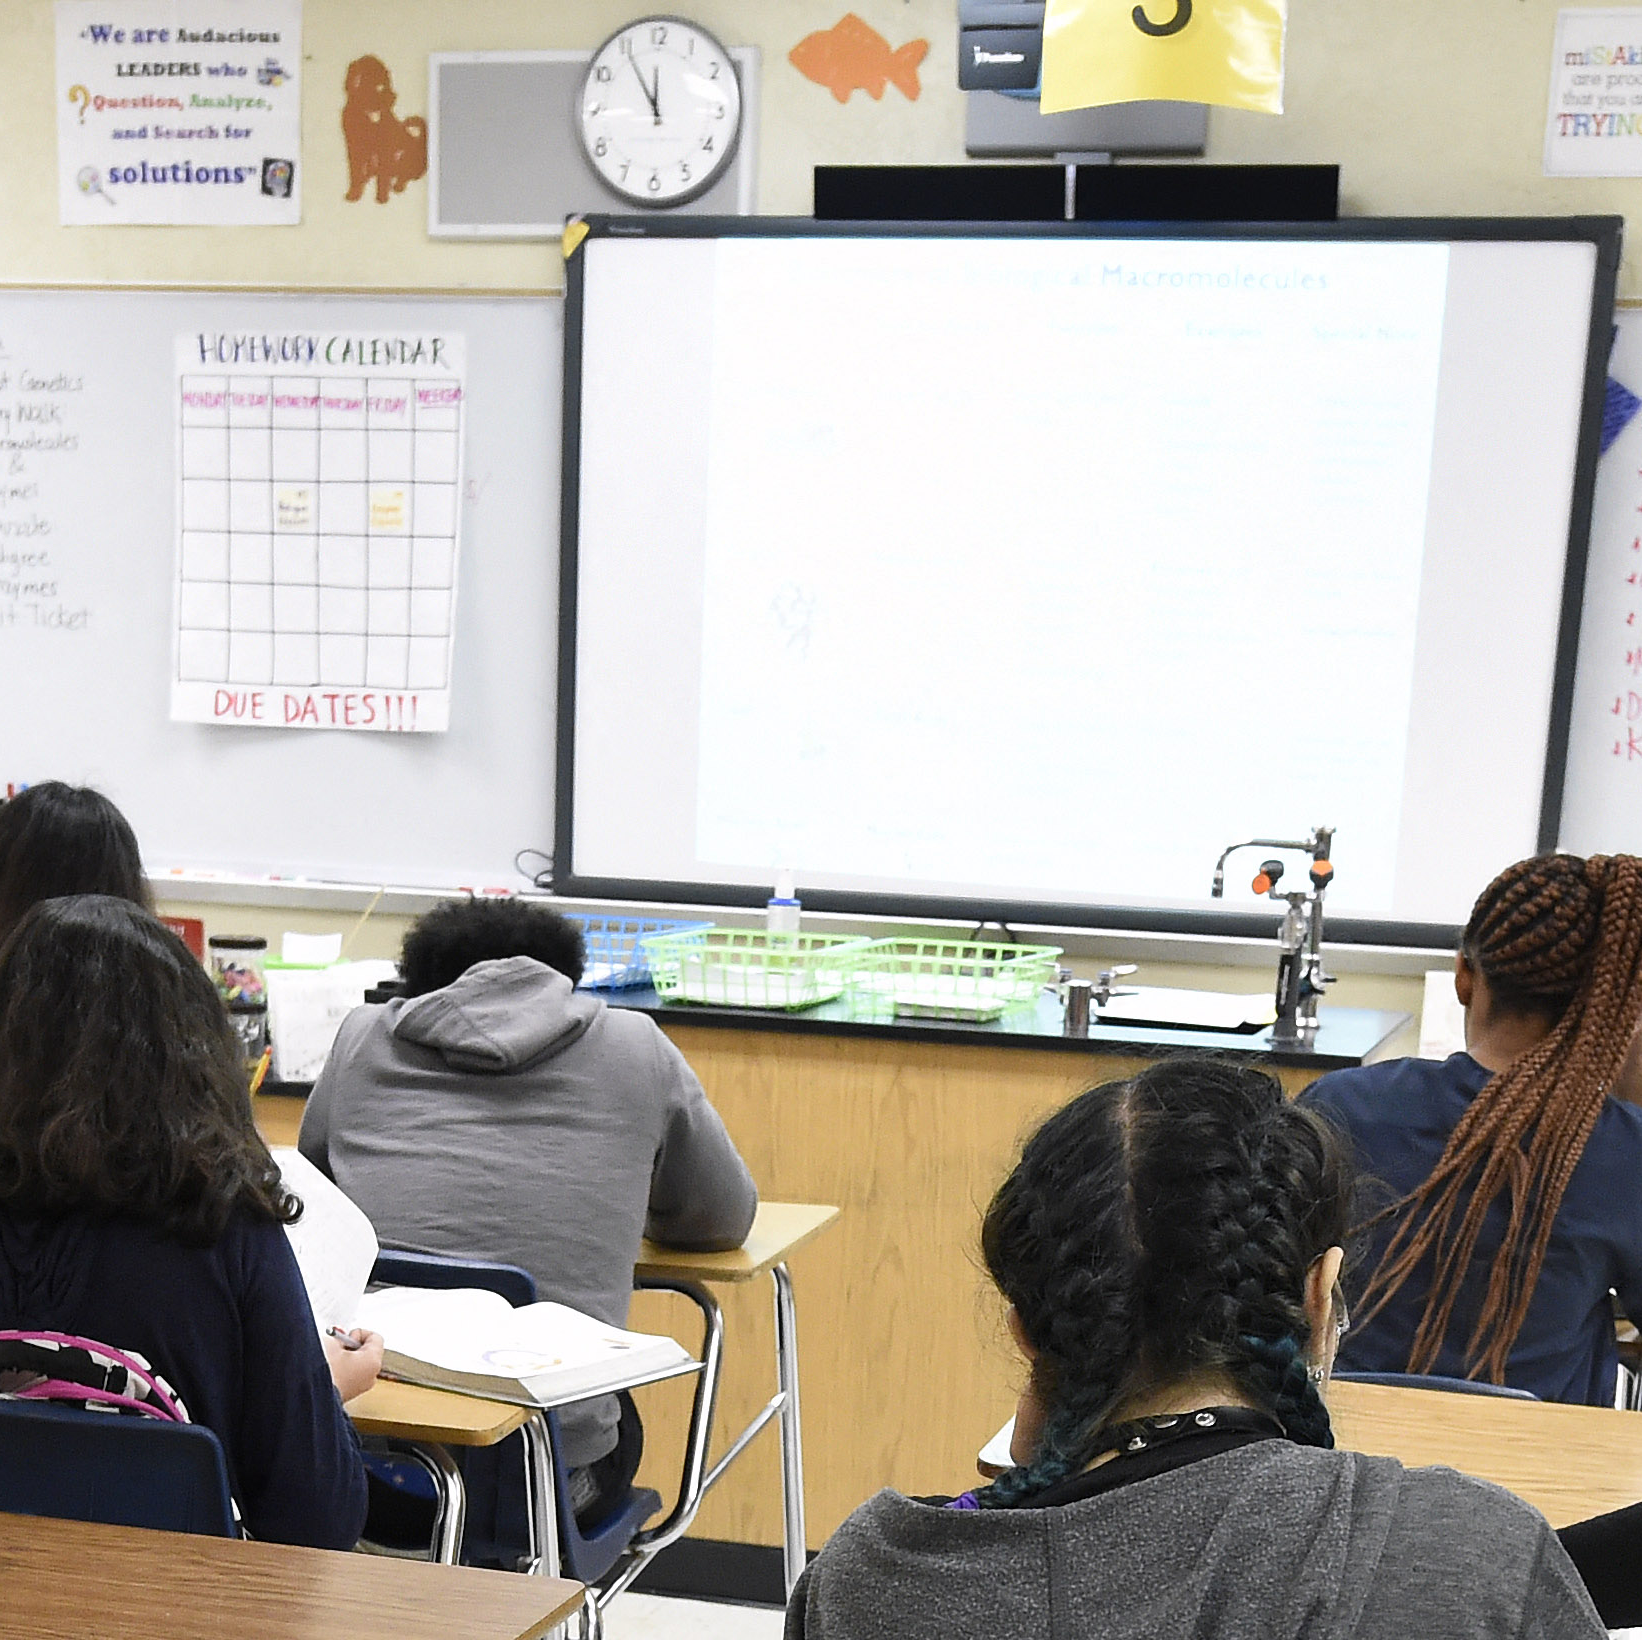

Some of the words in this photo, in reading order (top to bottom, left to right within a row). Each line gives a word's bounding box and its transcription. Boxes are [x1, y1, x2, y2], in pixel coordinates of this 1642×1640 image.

[132, 28, 170, 44] are
[177, 28, 281, 44] Audacious
[651, 26, 668, 45] 12
[116, 62, 202, 77] LEADERS
[206, 62, 247, 77] who
[596, 66, 612, 83] 10
[709, 61, 719, 80] 2
[1572, 73, 1601, 87] are
[1562, 91, 1594, 106] that
[1597, 94, 1627, 110] you
[112, 126, 149, 140] and
[154, 126, 219, 140] Search
[225, 125, 253, 140] for
[595, 136, 608, 157] 8
[702, 136, 715, 152] 4
[619, 163, 631, 182] 7
[647, 174, 661, 191] 6
[1100, 264, 1330, 293] Macromolecules
[197, 333, 320, 364] HOMEWORK
[324, 335, 452, 370] CALENDAR
[19, 368, 84, 392] Genetics
[24, 602, 92, 631] Ticket
[213, 688, 265, 720] DUE
[283, 692, 421, 733] DATES!!!
